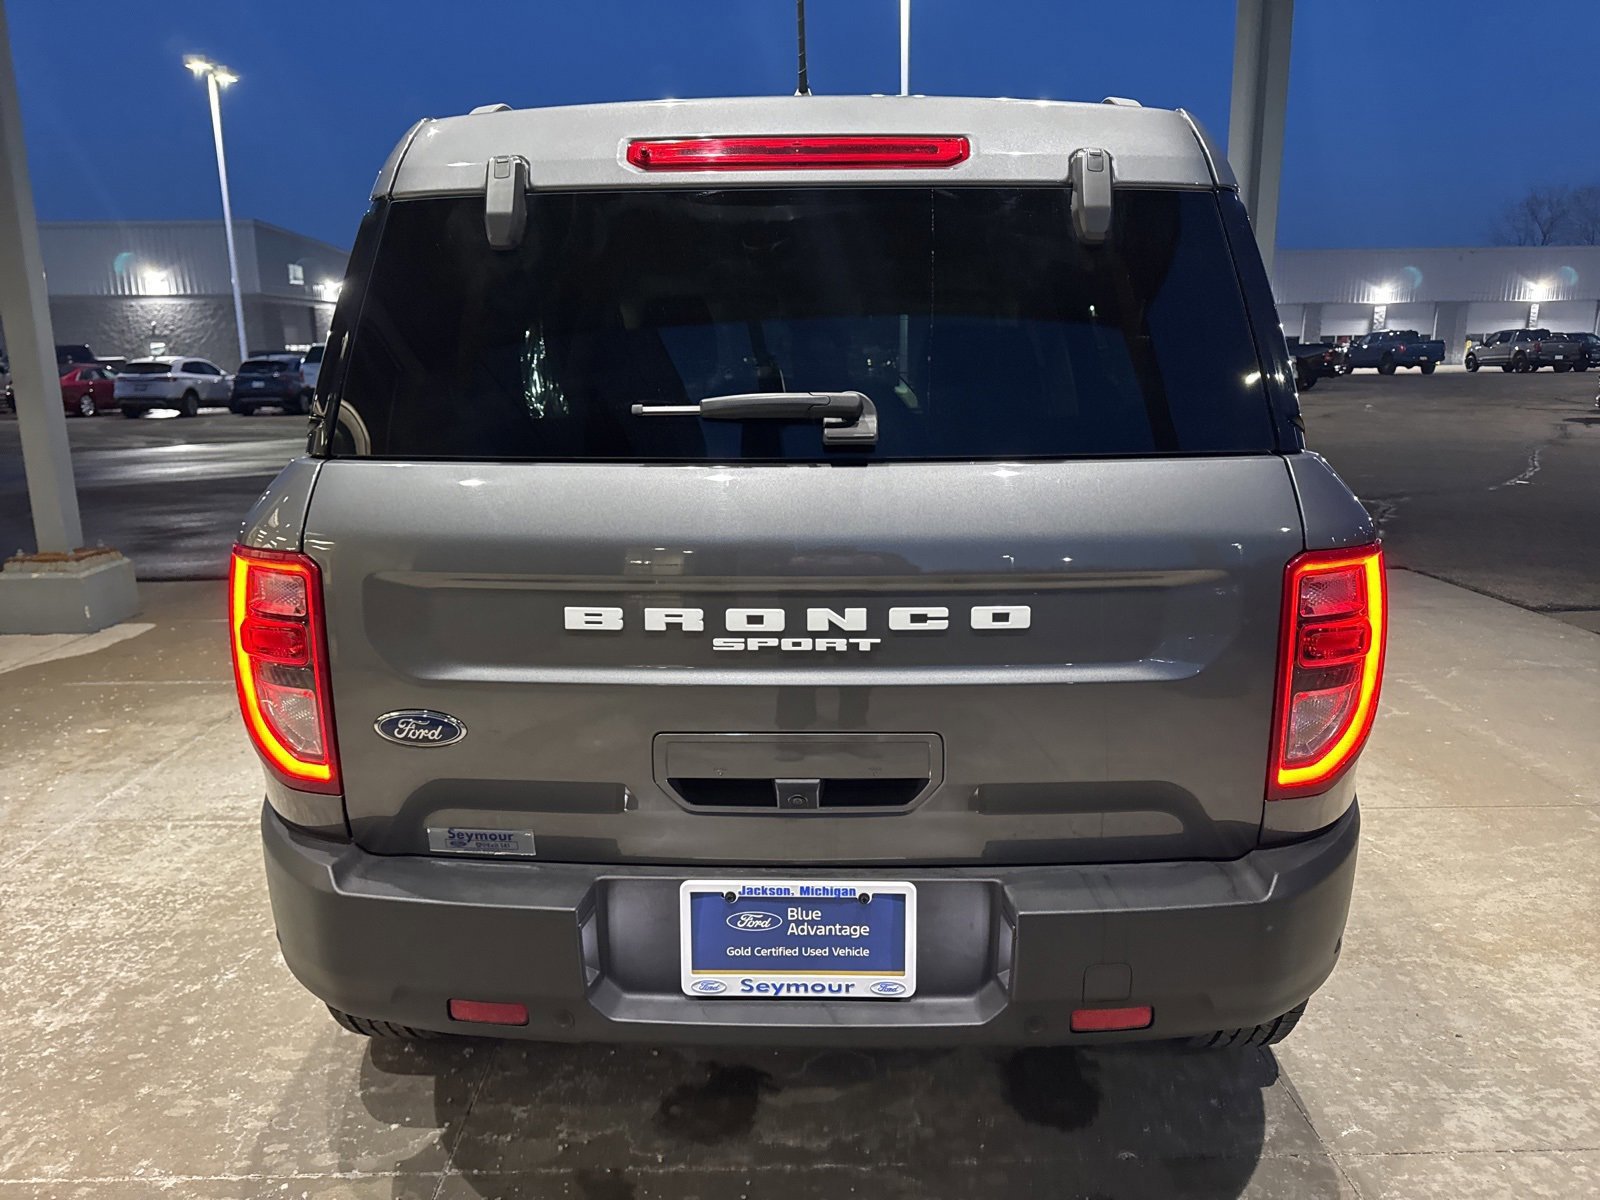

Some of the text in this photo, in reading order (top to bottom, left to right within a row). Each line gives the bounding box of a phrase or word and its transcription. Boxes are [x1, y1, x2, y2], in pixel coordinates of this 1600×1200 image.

[563, 606, 1032, 633] BRONCO
[712, 637, 882, 652] SPORT
[393, 718, 443, 741] Ford
[447, 827, 514, 842] Seymour
[738, 885, 857, 899] Jackson, Michigan
[736, 913, 772, 928] Ford
[787, 907, 822, 921] Blue
[787, 922, 870, 939] Advantage
[726, 946, 870, 957] Gold Certified Used Vehicle
[698, 980, 721, 991] Ford
[740, 978, 856, 996] Seymour
